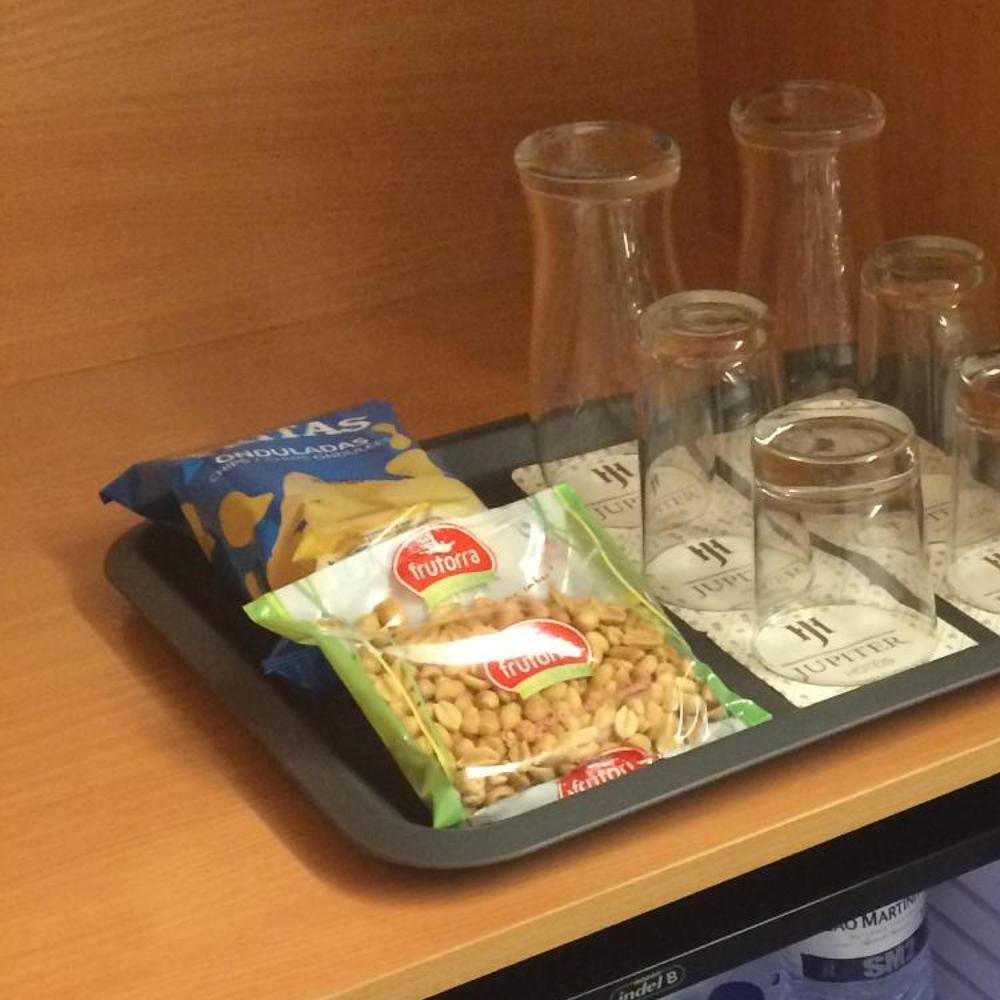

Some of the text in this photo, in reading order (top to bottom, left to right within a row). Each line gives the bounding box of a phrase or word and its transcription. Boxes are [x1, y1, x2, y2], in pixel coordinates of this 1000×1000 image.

[215, 436, 369, 465] ONDULADAS
[408, 549, 481, 581] frutorra
[793, 636, 913, 682] JUPITER
